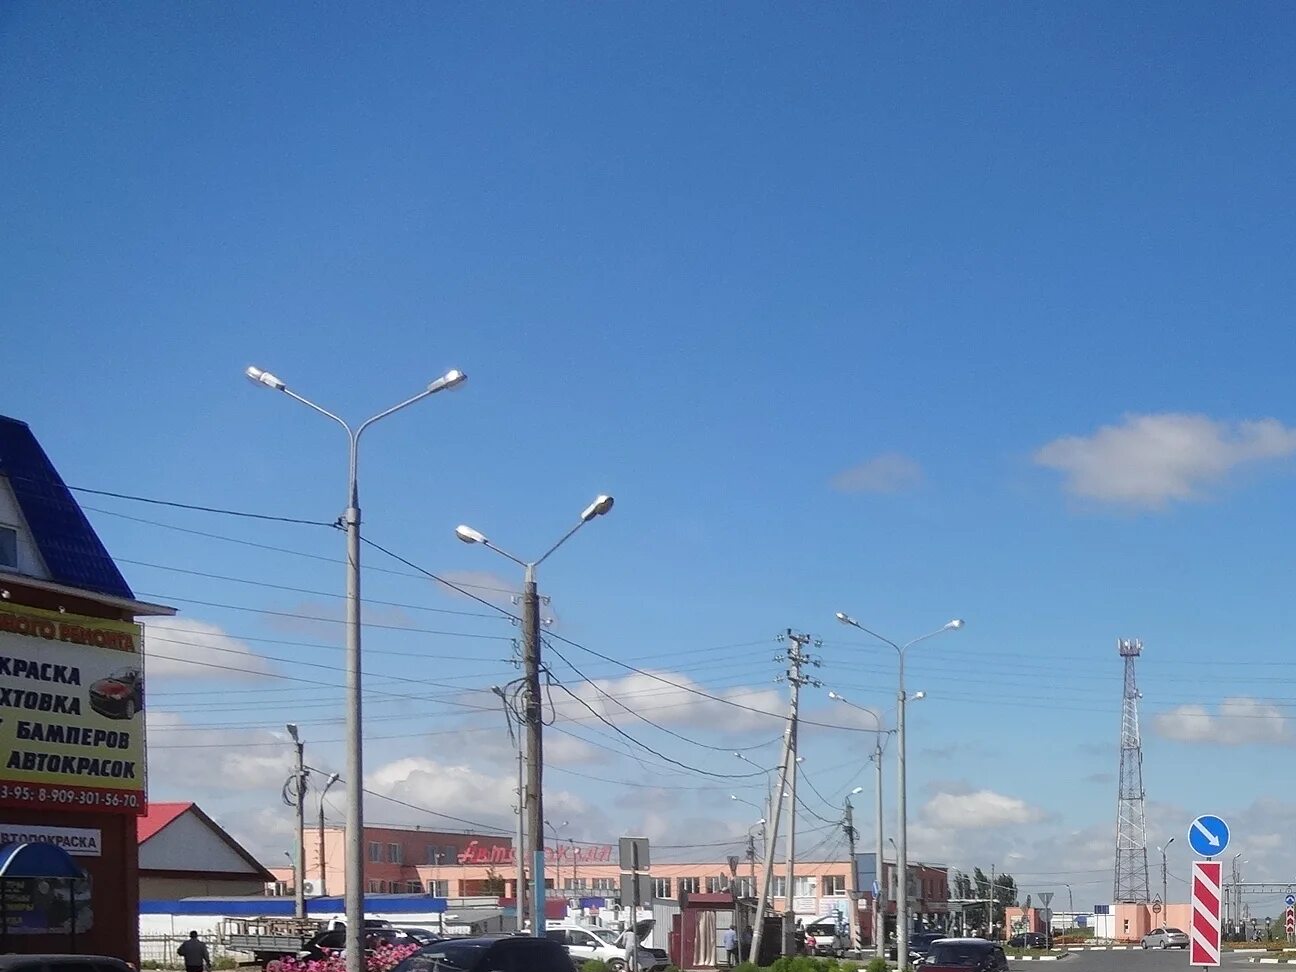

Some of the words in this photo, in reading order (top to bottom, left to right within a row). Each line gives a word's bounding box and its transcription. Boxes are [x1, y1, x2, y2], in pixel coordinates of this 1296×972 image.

[0, 656, 81, 687] КРАСКА
[0, 687, 81, 716] ХТОВКА
[16, 720, 130, 750] БАМПЕРОВ
[6, 750, 136, 779] АВТОКРАСОК
